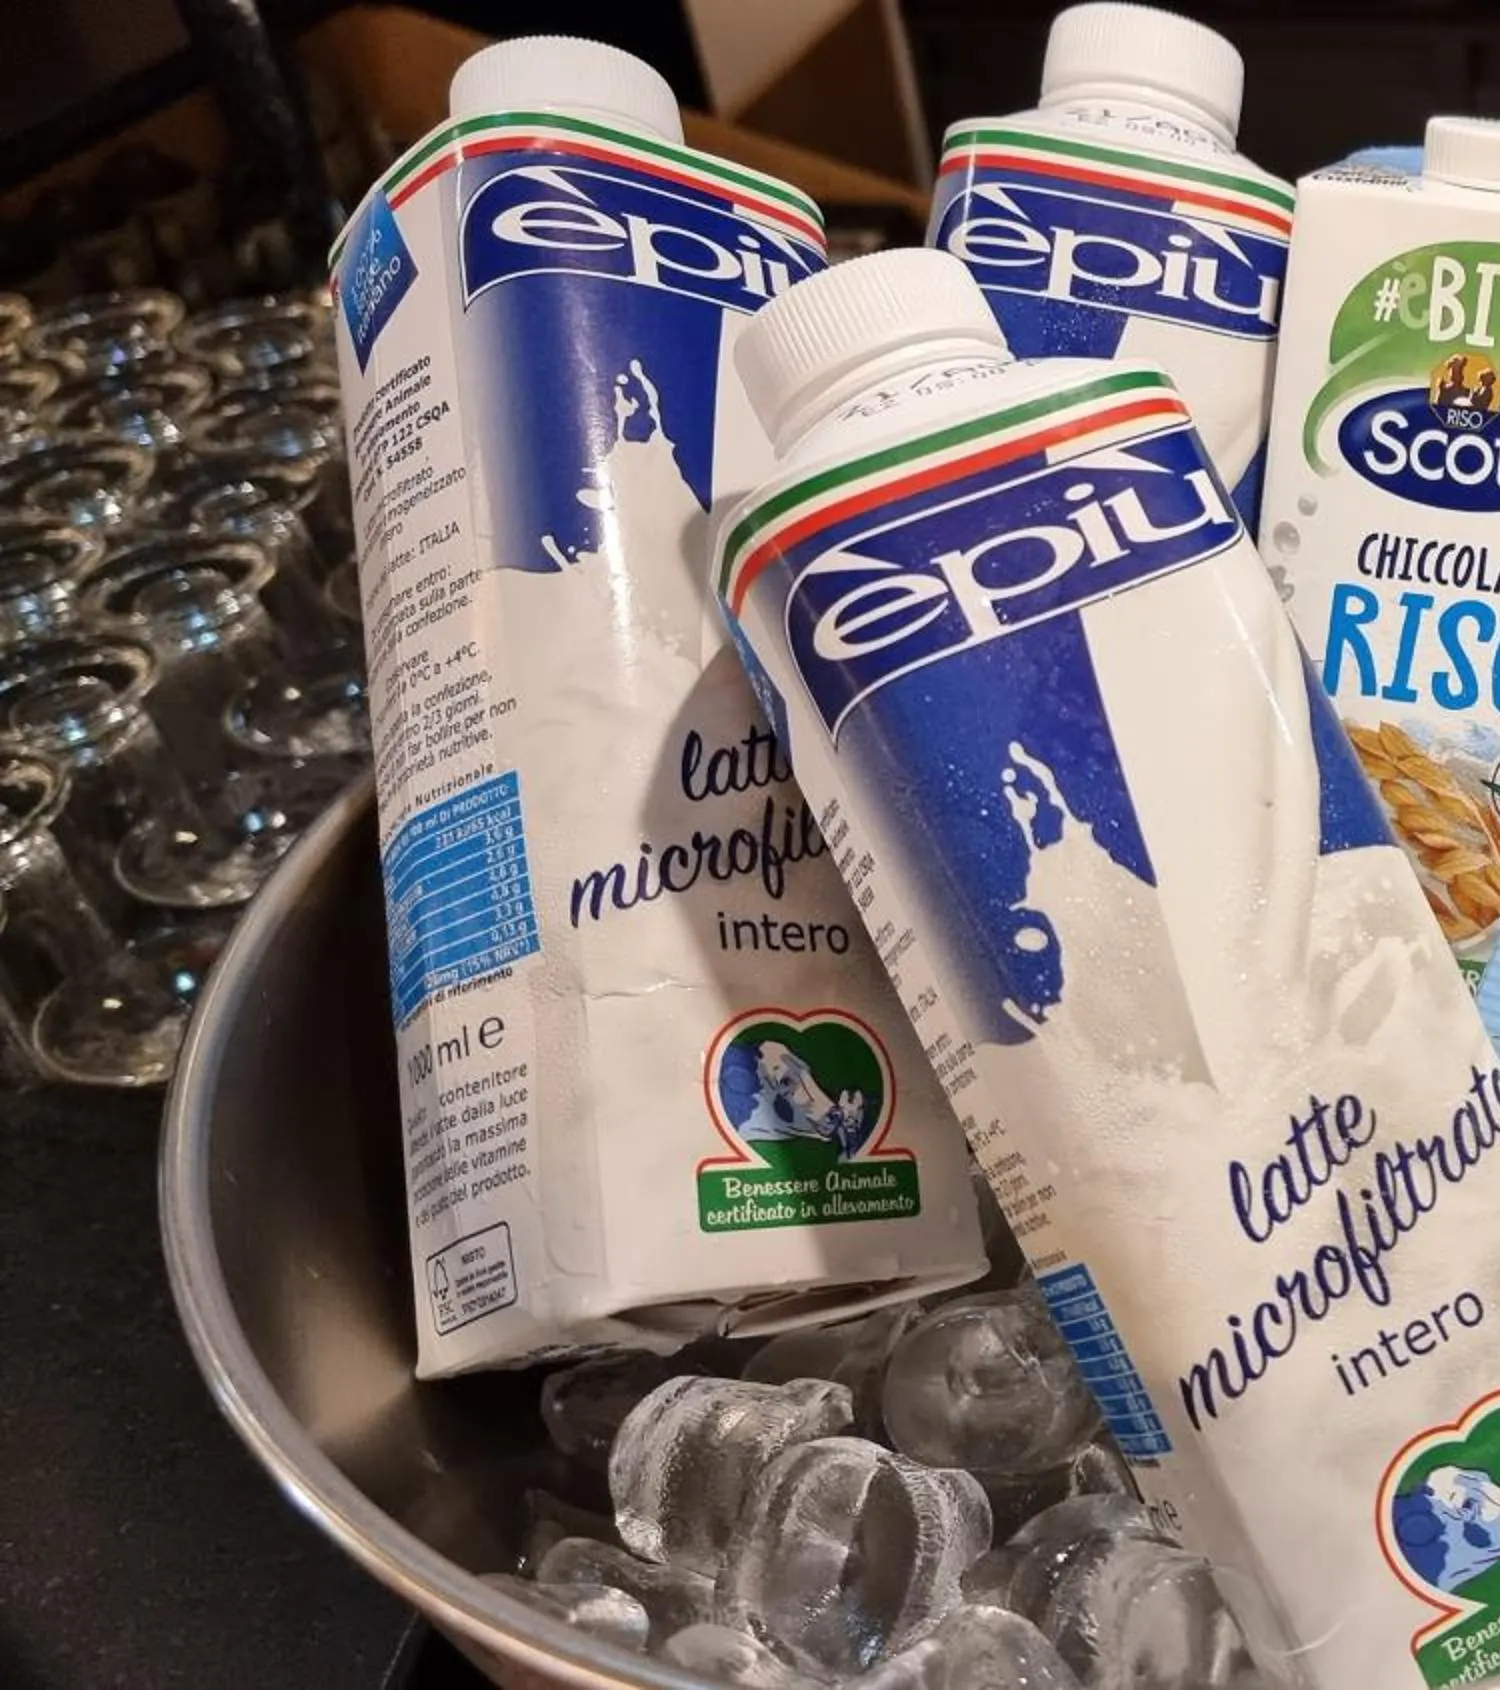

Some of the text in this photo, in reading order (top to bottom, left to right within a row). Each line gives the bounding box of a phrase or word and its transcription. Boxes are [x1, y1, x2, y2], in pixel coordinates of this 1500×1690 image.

[385, 374, 432, 413] Animale
[415, 401, 451, 430] CSQA
[1446, 408, 1484, 430] RISO
[419, 520, 461, 555] ITALIA
[808, 446, 1236, 661] èpiù
[449, 567, 483, 597] parte
[405, 595, 473, 638] confezione.
[423, 668, 493, 711] confezione,
[463, 708, 486, 732] per
[489, 697, 518, 719] non
[682, 725, 793, 802] latt
[415, 762, 494, 806] Nutrizionale
[569, 796, 830, 929] microfil
[716, 911, 850, 955] intero
[447, 966, 514, 996] riferimento
[437, 1024, 471, 1067] ml
[438, 1062, 528, 1107] contenitore
[461, 1100, 496, 1124] dalla
[499, 1086, 529, 1109] luce
[465, 1111, 529, 1147] massima
[471, 1136, 528, 1170] vitamine
[1228, 1094, 1377, 1244] latte
[471, 1161, 531, 1199] prodotto.
[720, 1166, 898, 1200] Benessere Animale
[706, 1192, 916, 1227] certificato in allevamento
[1330, 1291, 1485, 1397] intero
